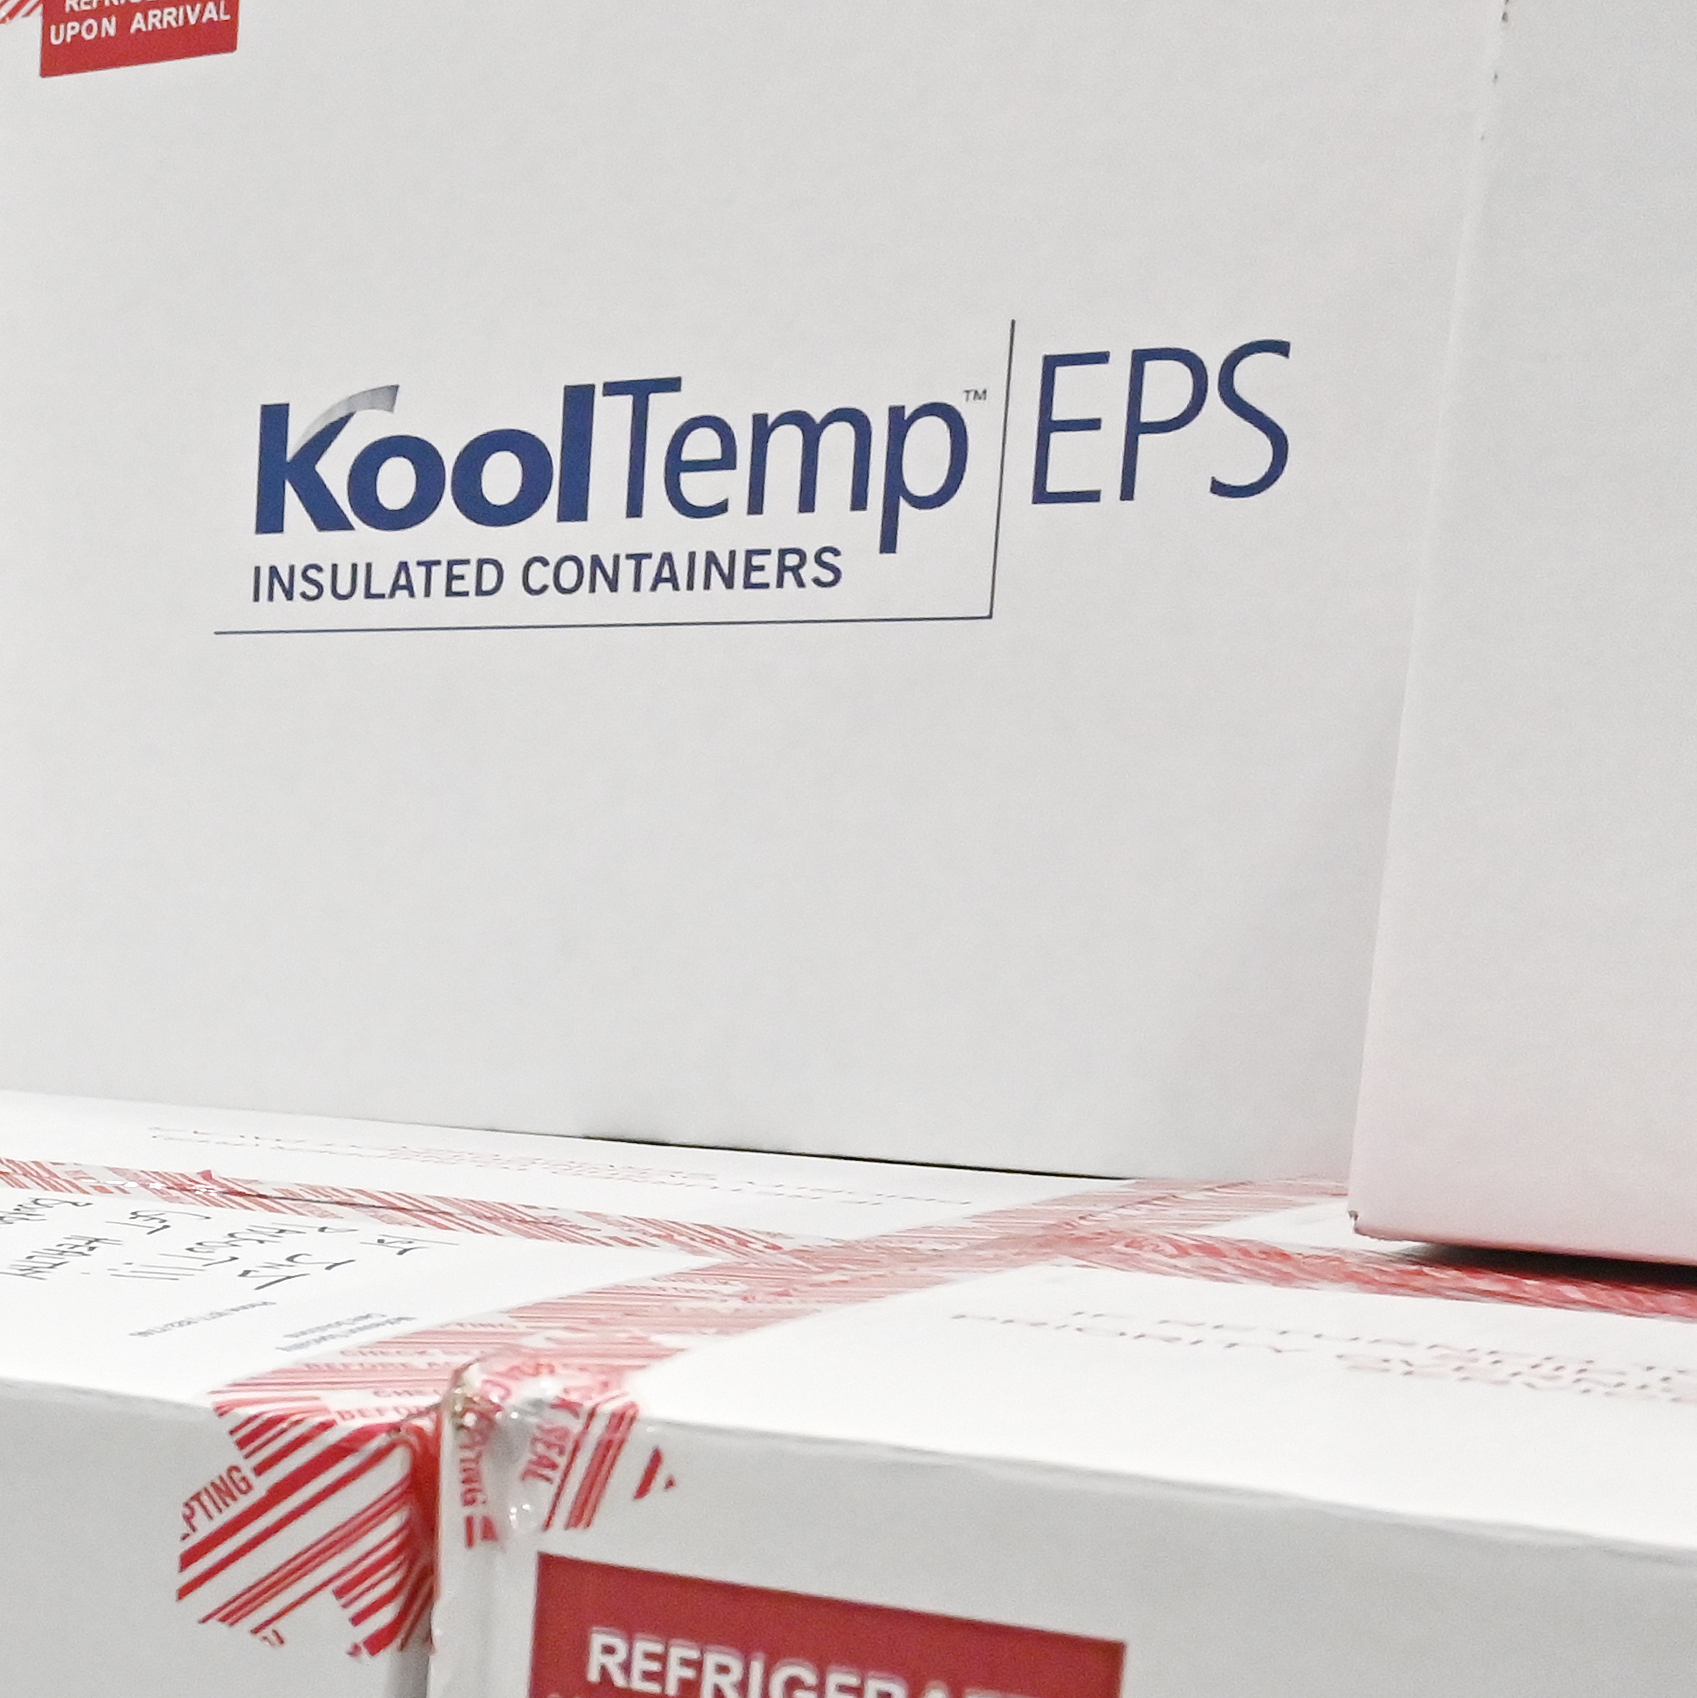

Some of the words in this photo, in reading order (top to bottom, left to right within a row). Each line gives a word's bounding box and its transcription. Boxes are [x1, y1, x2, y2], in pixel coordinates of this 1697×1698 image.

[49, 16, 118, 46] UPON
[128, 0, 232, 34] ARRIVAL
[254, 376, 968, 556] KoolTemp
[1031, 338, 1292, 506] EPS
[251, 557, 505, 604] INSULATED
[520, 545, 843, 597] CONTAINERS
